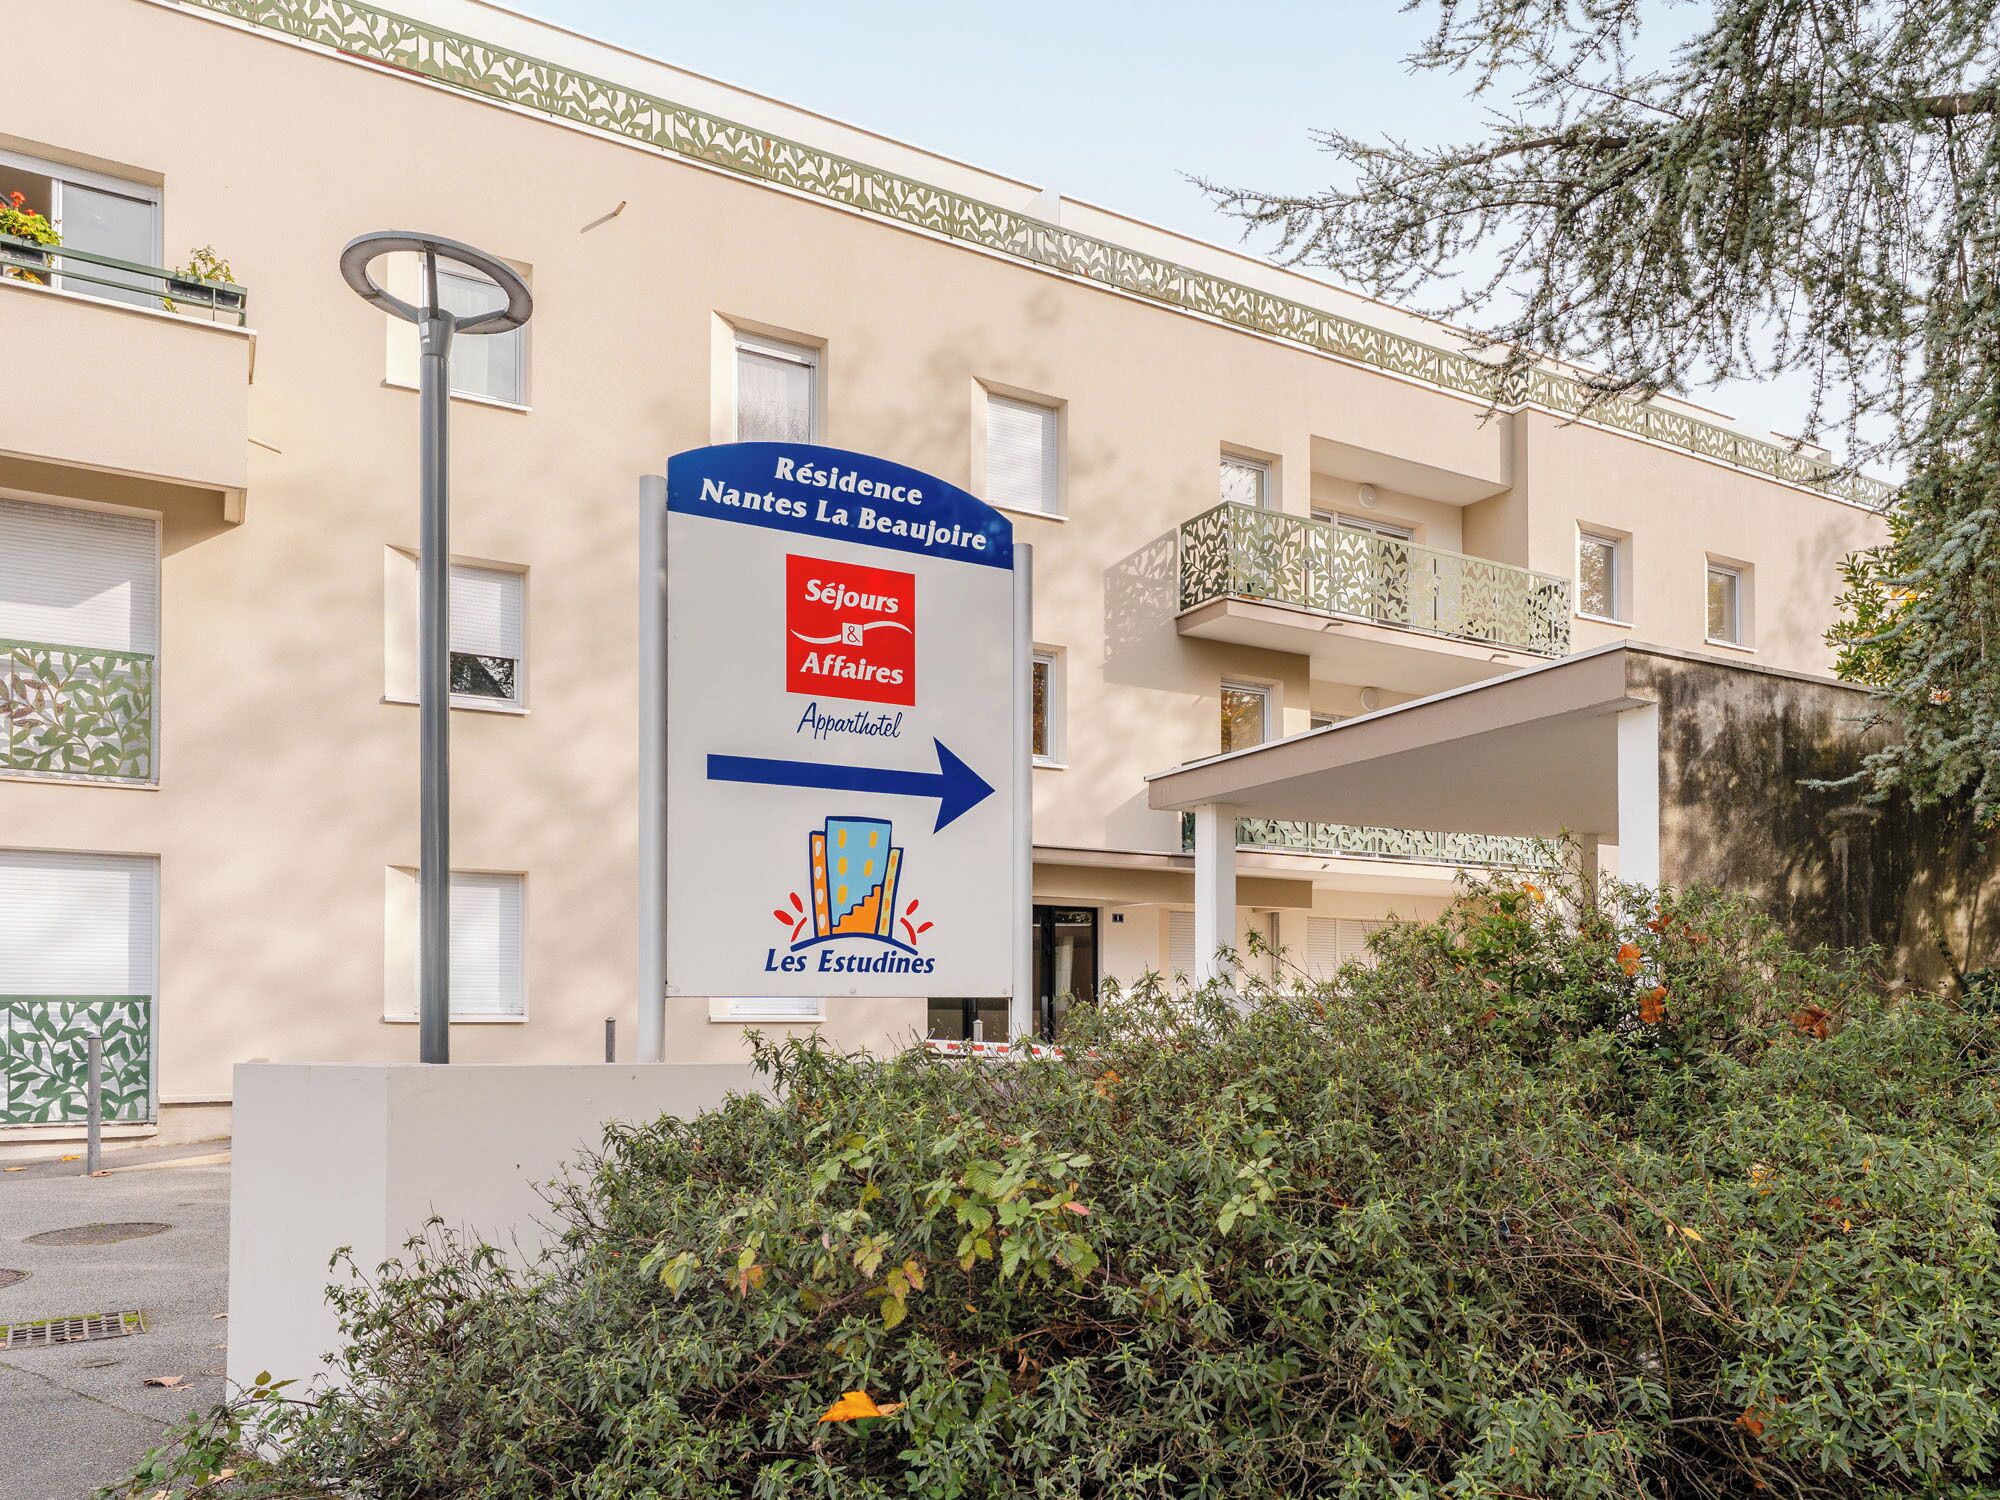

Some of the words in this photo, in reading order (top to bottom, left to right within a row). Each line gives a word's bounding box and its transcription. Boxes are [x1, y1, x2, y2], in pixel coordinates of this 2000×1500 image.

[775, 456, 923, 505] Résidence
[699, 478, 807, 518] Nantes
[815, 500, 849, 526] La
[858, 508, 987, 550] Beaujoire
[804, 579, 899, 614] Séjours
[846, 625, 860, 643] &
[800, 653, 904, 685] Affaires
[797, 702, 903, 740] Apparthotel
[764, 948, 807, 973] Les
[817, 949, 935, 974] Estudines
